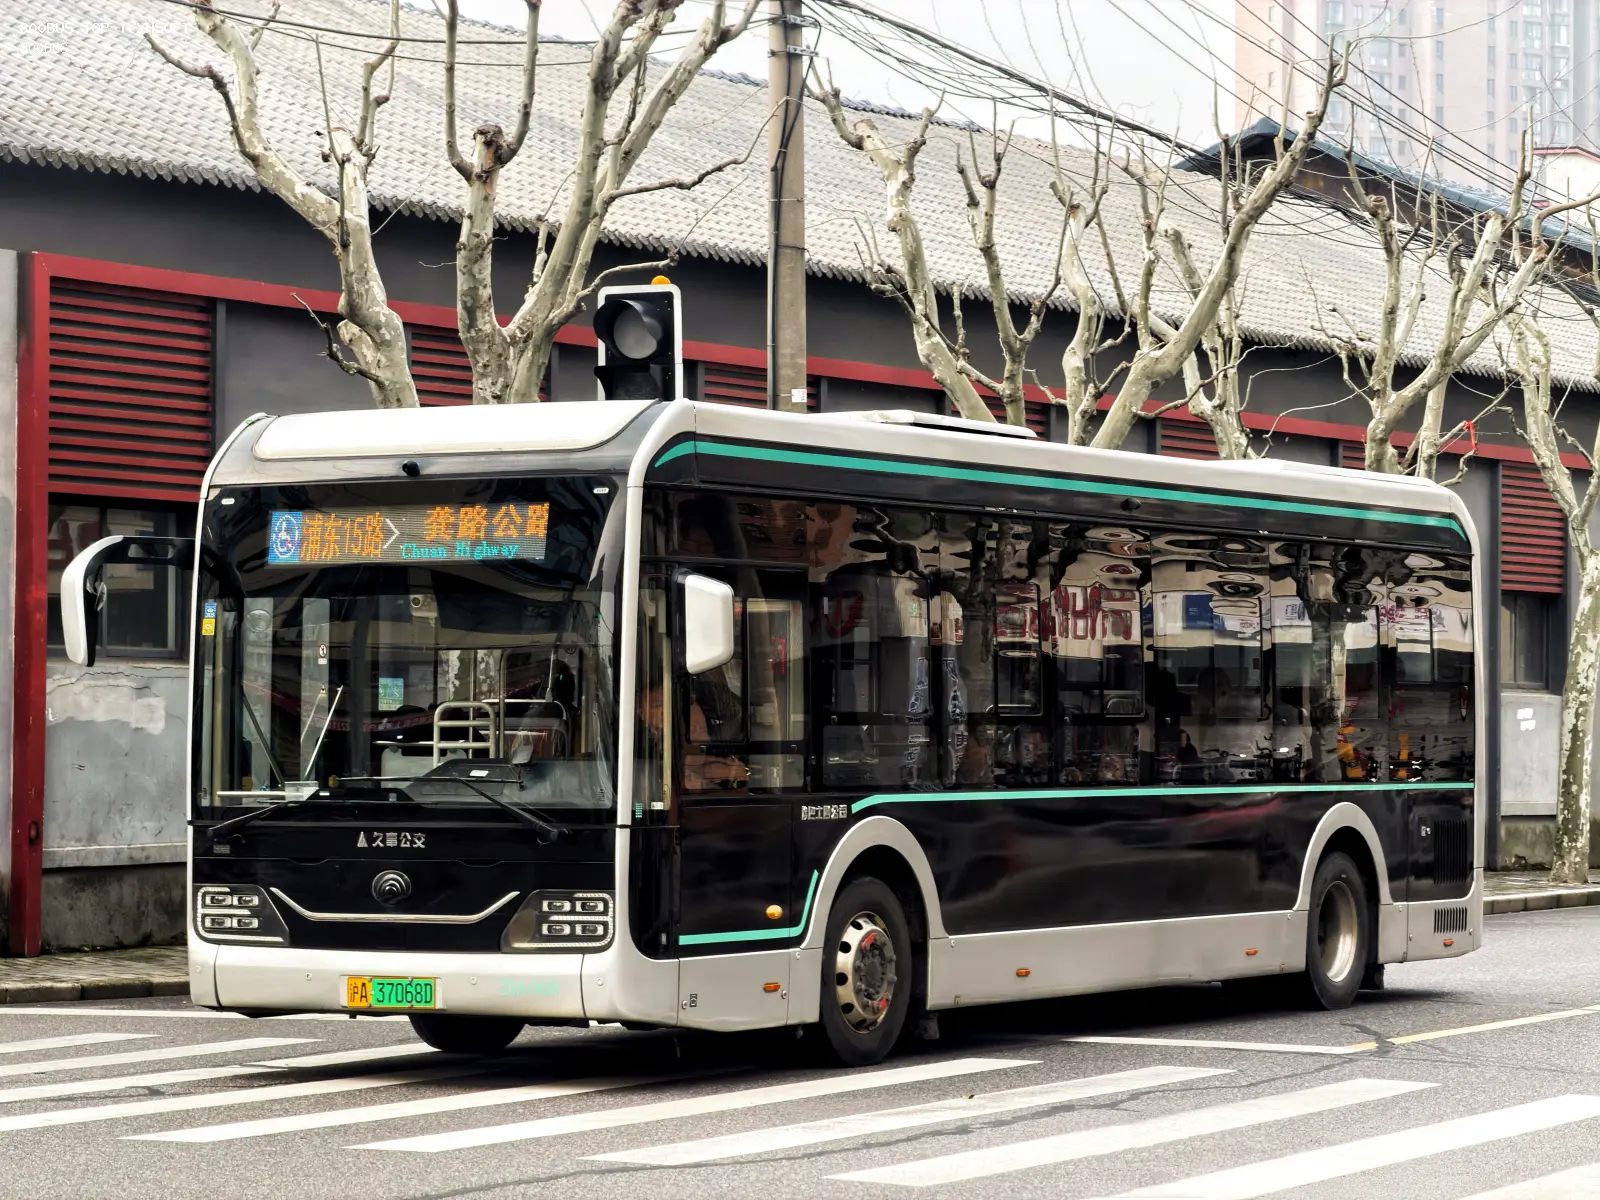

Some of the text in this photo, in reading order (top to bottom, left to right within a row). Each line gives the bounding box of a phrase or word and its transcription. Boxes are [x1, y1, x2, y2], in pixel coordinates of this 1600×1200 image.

[299, 512, 385, 561] 浦东15路
[401, 540, 519, 560] Chuan Highway
[371, 831, 427, 849] 久事公交
